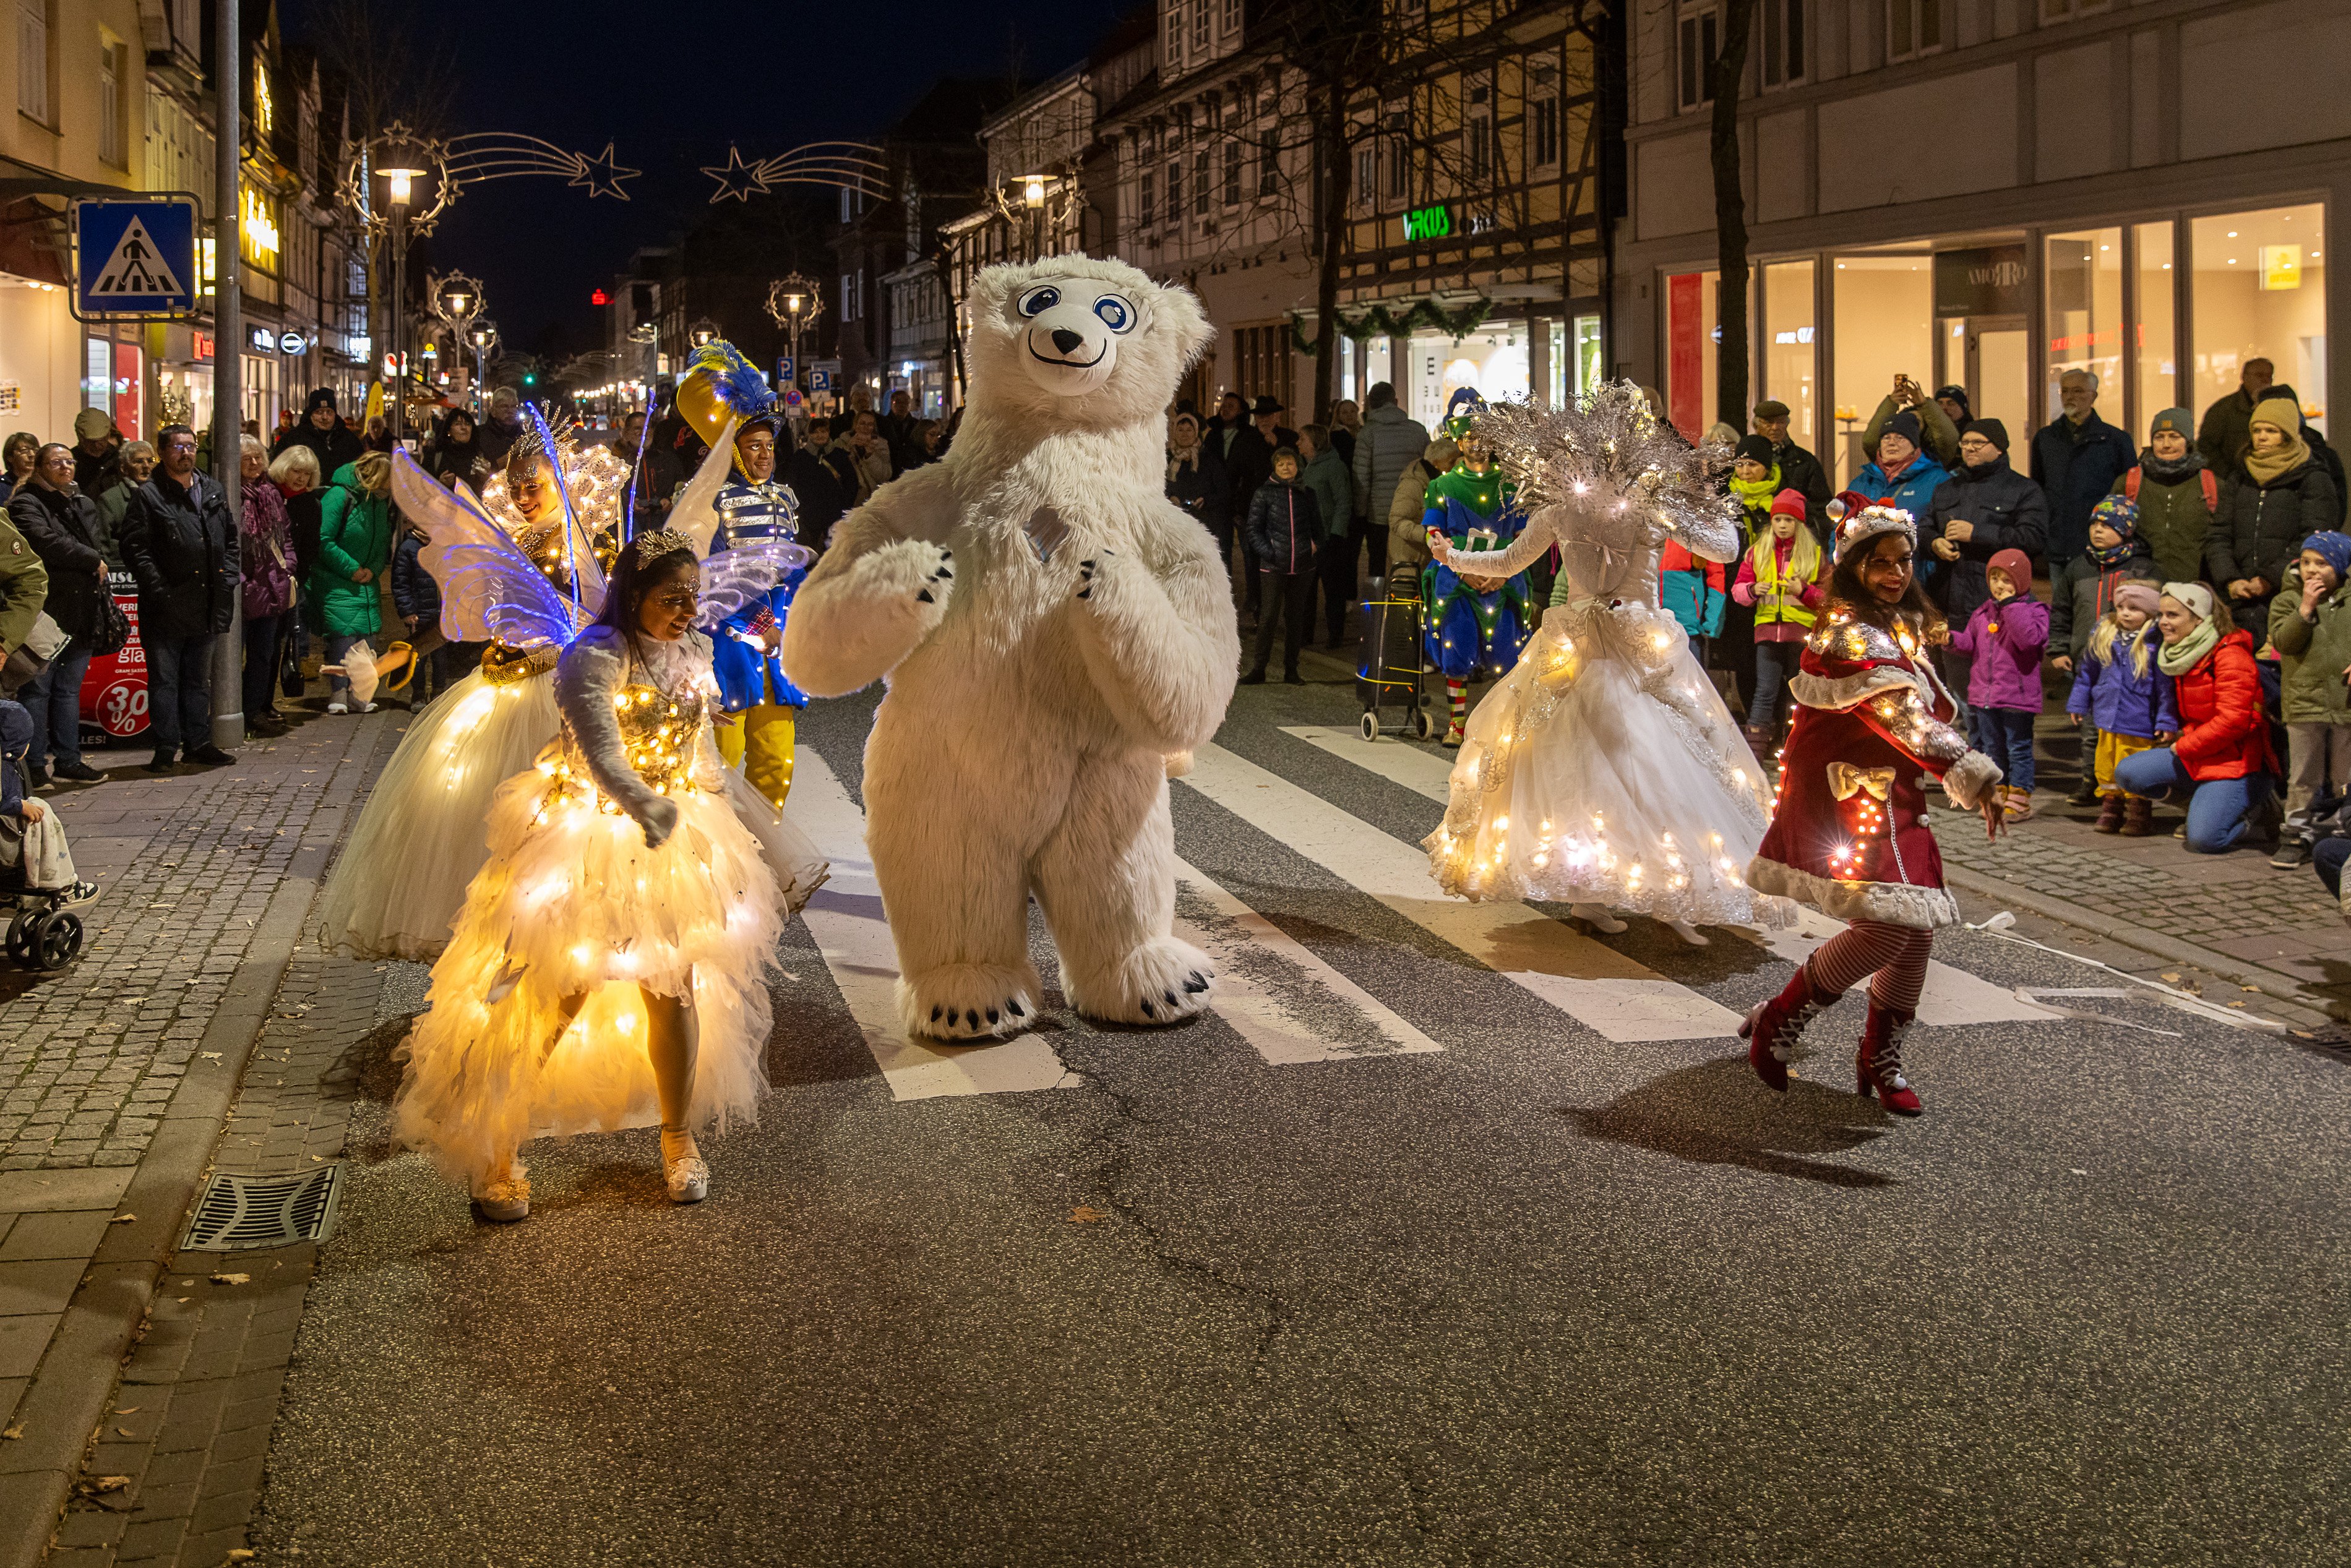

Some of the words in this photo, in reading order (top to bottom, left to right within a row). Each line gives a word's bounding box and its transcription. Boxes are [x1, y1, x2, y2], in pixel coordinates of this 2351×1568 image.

[780, 360, 791, 377] P
[812, 373, 823, 388] P
[107, 686, 148, 716] 30
[79, 735, 106, 745] LES!
